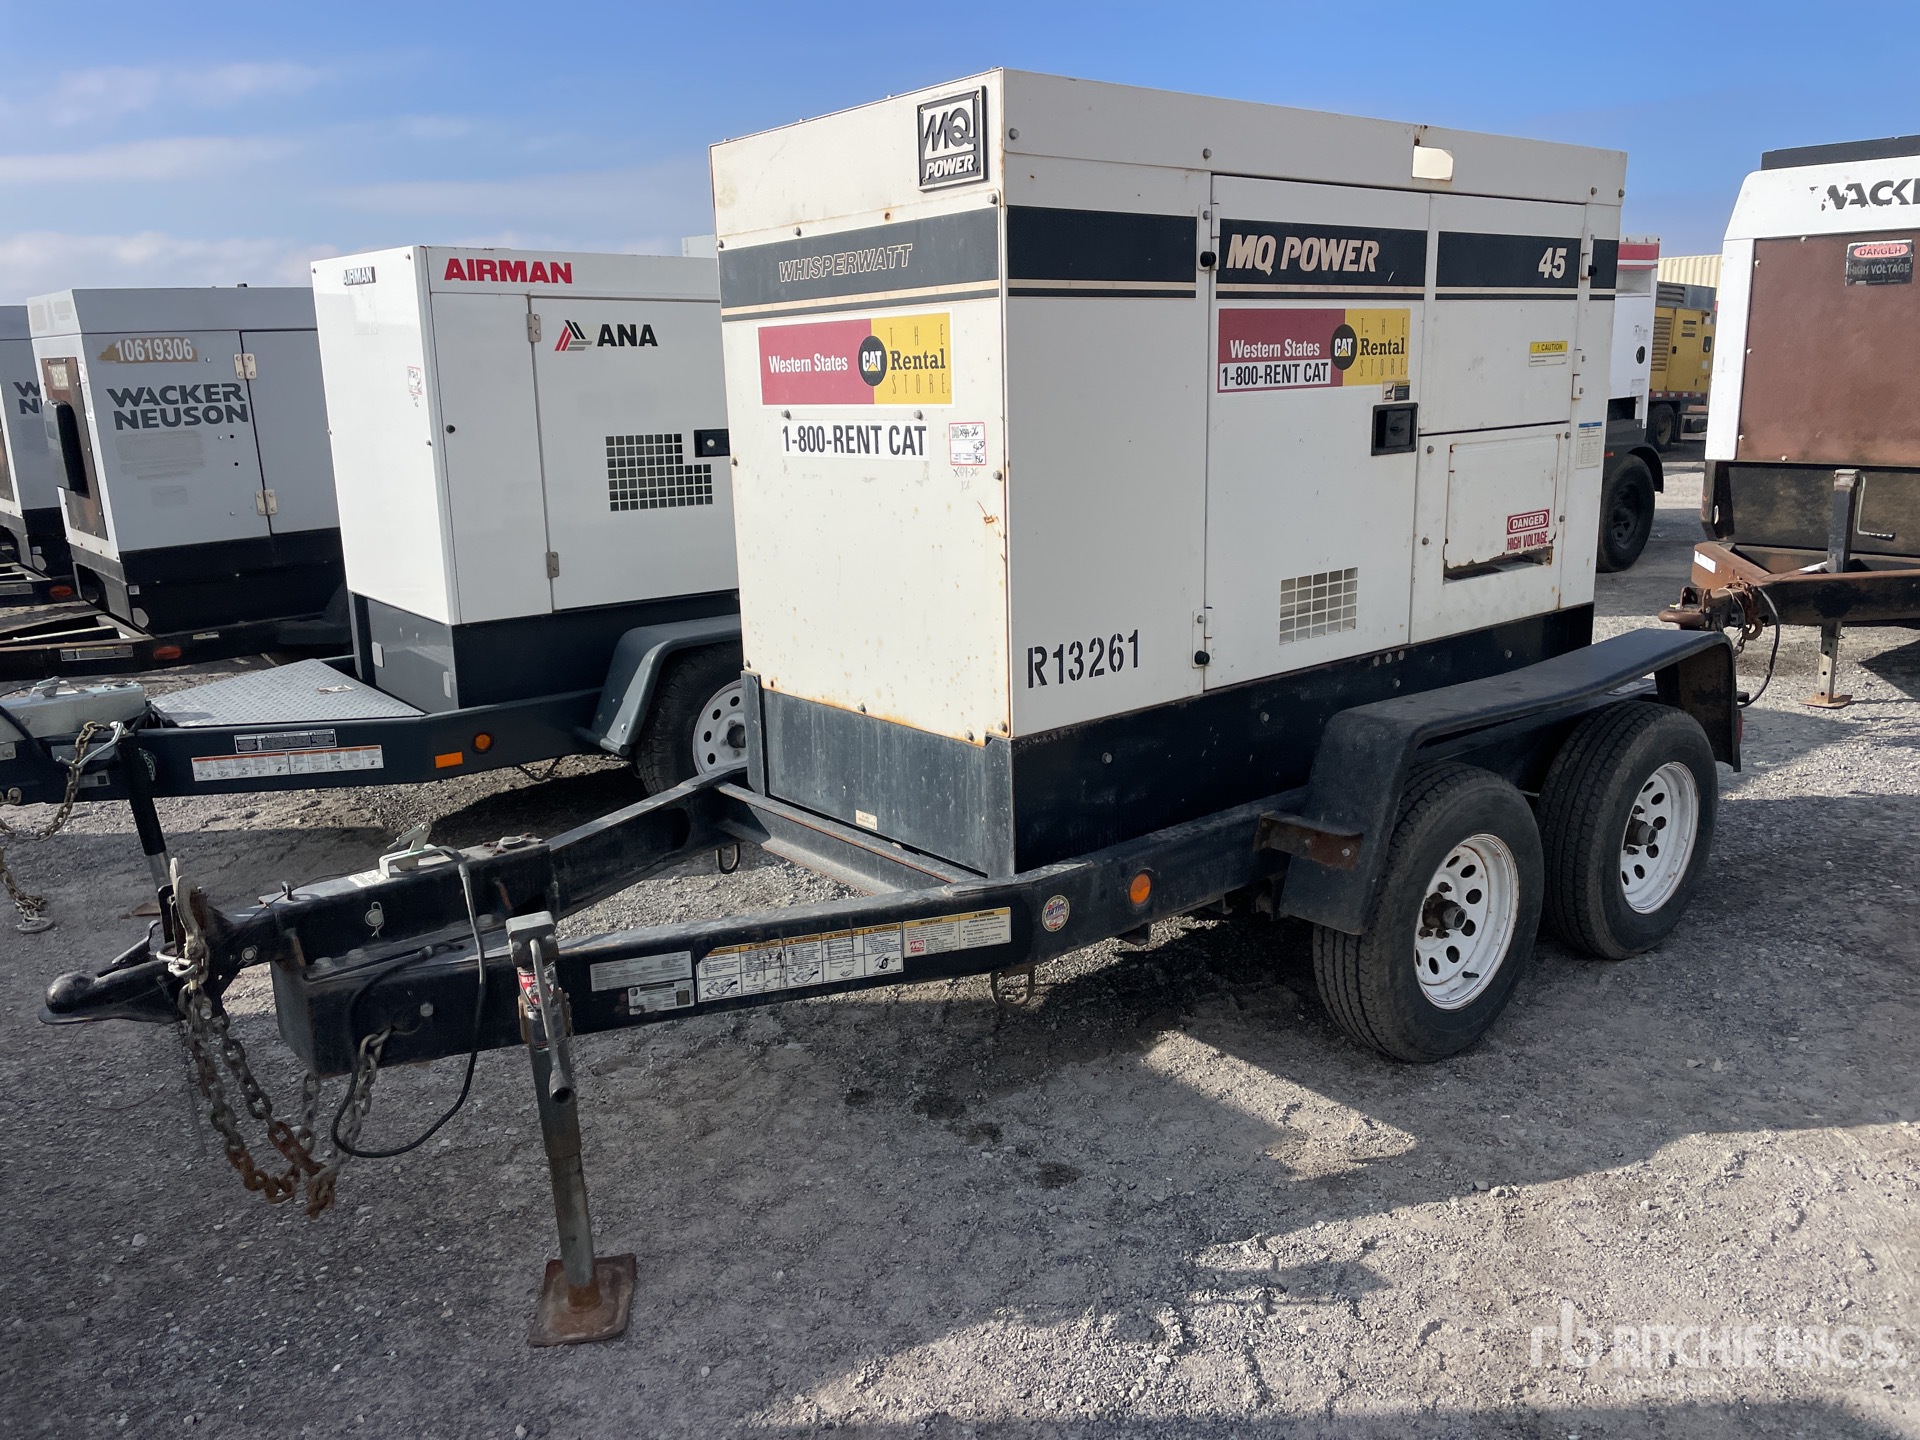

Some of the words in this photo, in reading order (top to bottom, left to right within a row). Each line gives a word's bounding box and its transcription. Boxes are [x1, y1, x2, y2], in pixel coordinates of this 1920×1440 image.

[925, 107, 974, 151] MQ
[926, 154, 975, 179] POWER
[778, 243, 913, 283] WHISPERWATT
[1226, 233, 1277, 276] MQ
[1280, 236, 1380, 272] POWER
[1538, 247, 1568, 279] 45
[1859, 246, 1901, 256] DANGER
[444, 257, 573, 284] AIRMAN
[1848, 262, 1869, 275] HIGH
[1871, 263, 1911, 275] VOLTAGE
[596, 323, 658, 347] ANA
[889, 324, 944, 347] THE
[1541, 343, 1563, 352] CAUTION
[115, 338, 194, 362] 10619306
[768, 354, 811, 373] Western
[814, 352, 848, 372] States
[862, 350, 882, 372] CAT
[890, 348, 946, 371] Rental
[1230, 339, 1281, 359] Western
[1284, 338, 1320, 357] States
[1334, 337, 1353, 357] CAT
[1359, 337, 1405, 356] Rental
[892, 373, 946, 395] STORE
[1222, 363, 1300, 387] 1-800-RENT
[1303, 362, 1329, 383] CAT
[106, 382, 245, 408] WACKER
[113, 403, 249, 431] NEUSON
[782, 425, 884, 455] 1-800-RENT
[888, 425, 927, 456] CAT
[1512, 515, 1545, 529] DANGER
[1507, 535, 1522, 550] HIGH
[1523, 530, 1548, 547] VOLTAGE
[1028, 629, 1138, 688] R13261
